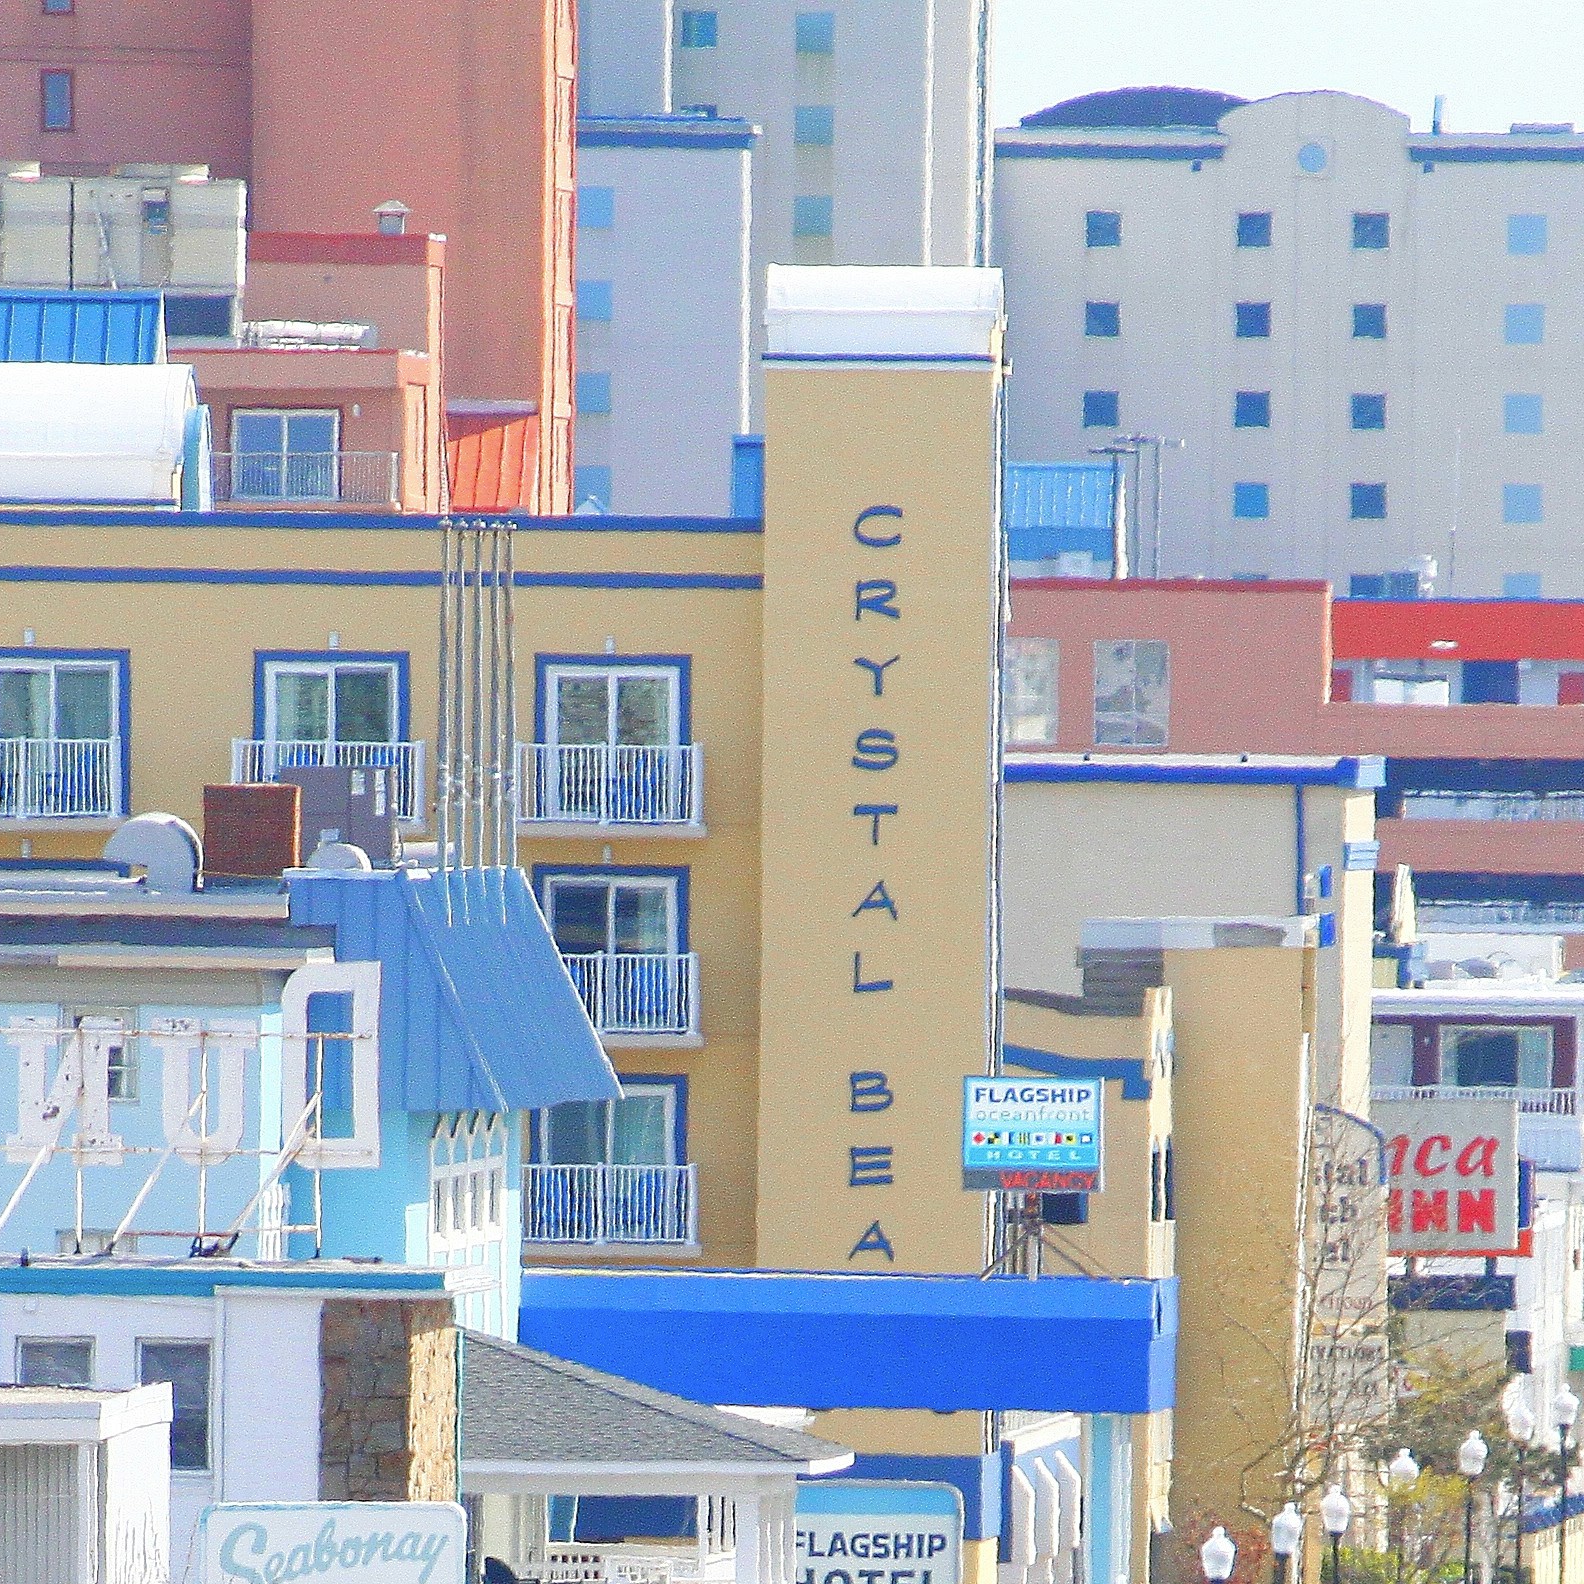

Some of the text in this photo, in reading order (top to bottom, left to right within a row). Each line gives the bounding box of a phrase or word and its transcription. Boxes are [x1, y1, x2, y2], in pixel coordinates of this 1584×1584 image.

[853, 504, 905, 994] CRYSTAL
[974, 1087, 1093, 1103] FLAGSHIP
[975, 1106, 1091, 1122] oceanfront
[999, 1170, 1098, 1191] VACANCY
